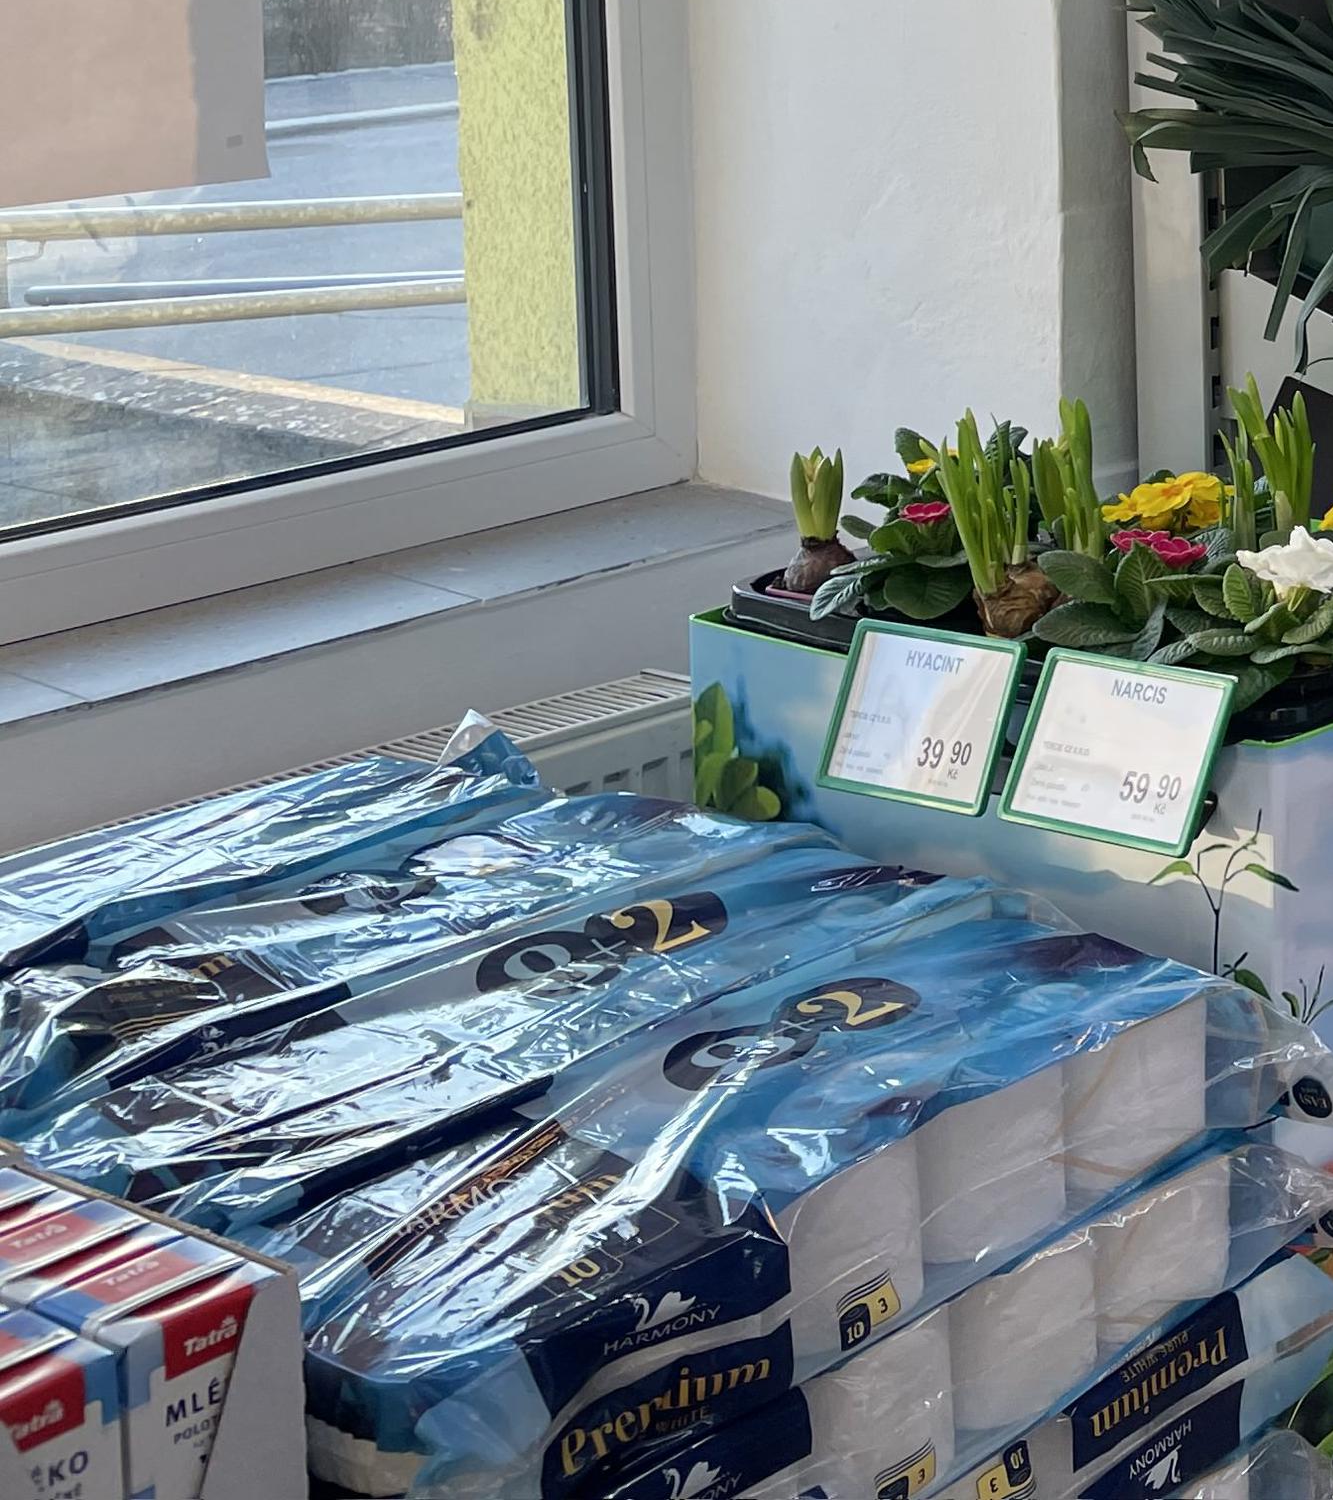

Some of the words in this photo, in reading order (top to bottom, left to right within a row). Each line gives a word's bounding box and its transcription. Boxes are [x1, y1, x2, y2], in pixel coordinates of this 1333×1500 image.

[905, 650, 964, 675] HYACINT
[1111, 680, 1166, 705] NARCIS
[918, 737, 944, 769] 39
[950, 740, 972, 766] 90
[947, 768, 958, 780] Kč
[1120, 772, 1148, 802] 59
[1156, 775, 1180, 800] 90
[1154, 802, 1166, 815] Kč
[878, 1298, 888, 1314] 3
[185, 1314, 238, 1356] Tatra
[604, 1305, 721, 1355] HARMONY
[846, 1322, 865, 1341] 10
[1090, 1327, 1229, 1438] Premium
[1121, 1353, 1154, 1384] WHITE
[561, 1357, 771, 1477] Premium
[1128, 1418, 1191, 1479] HARMONY
